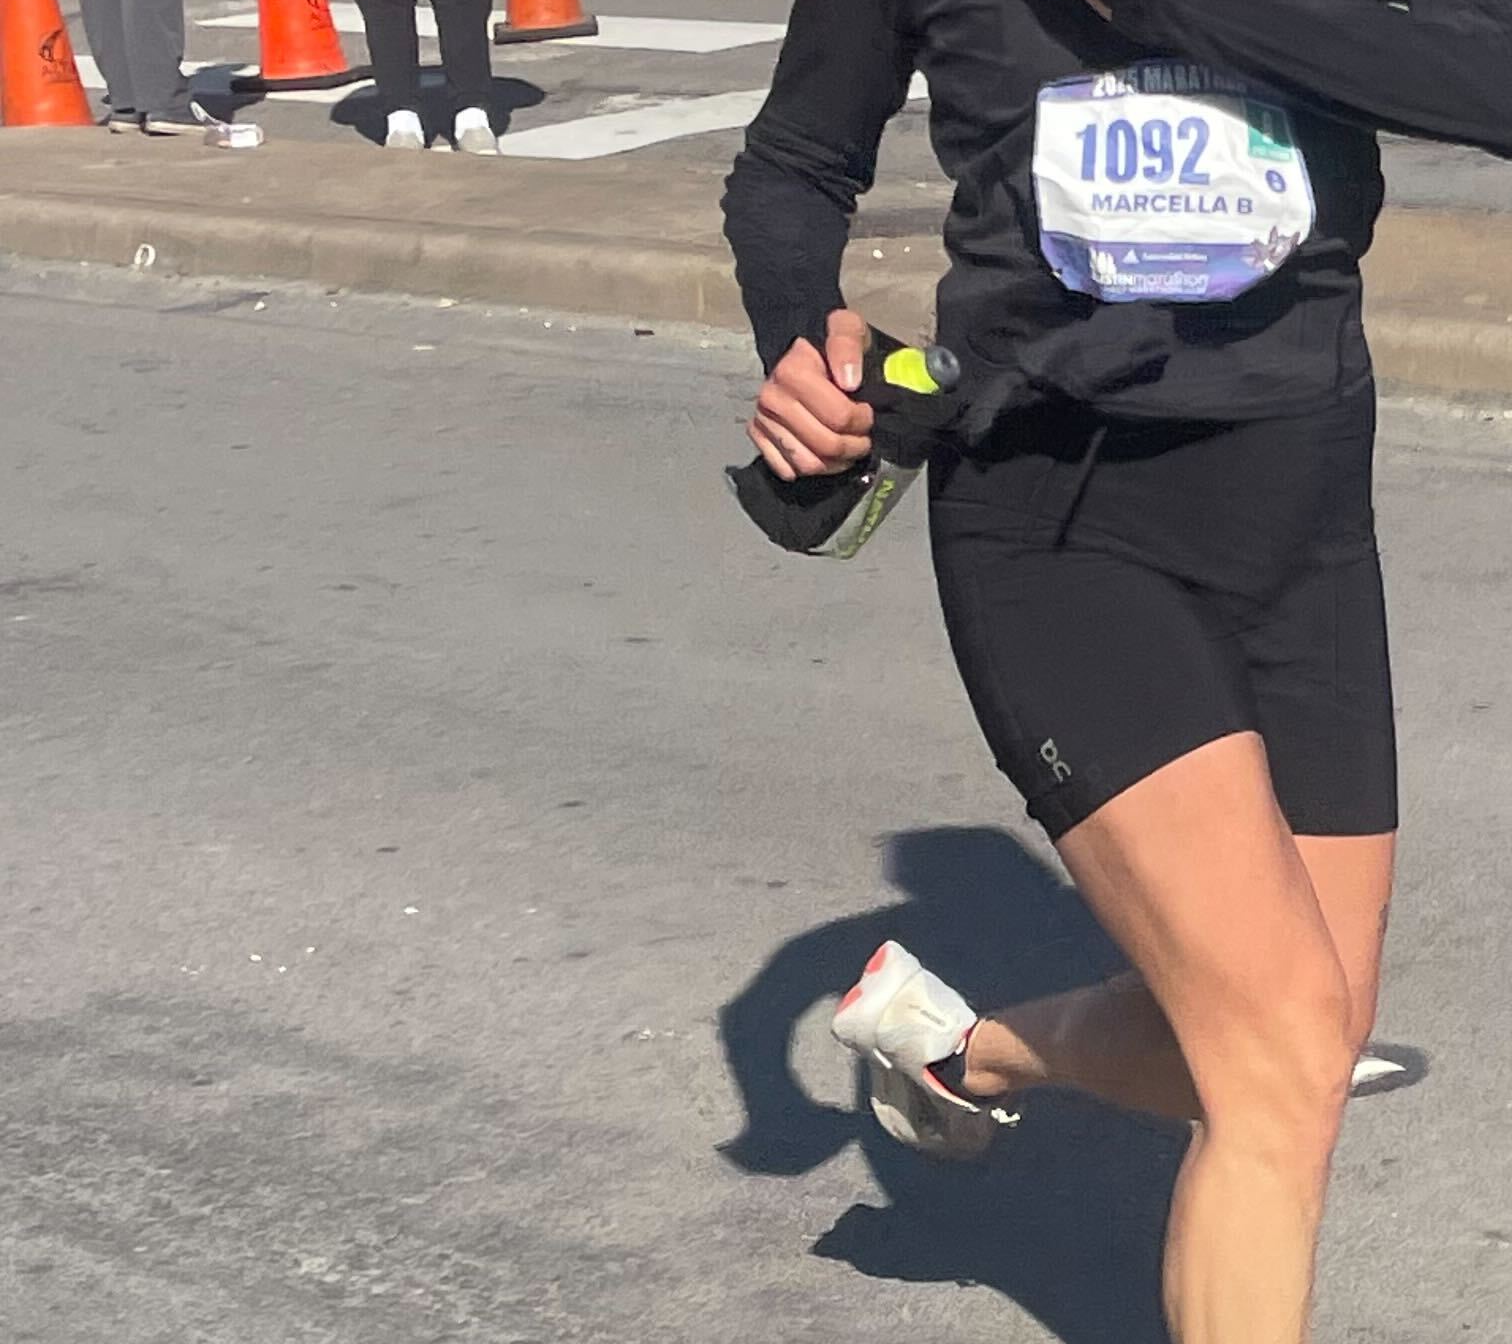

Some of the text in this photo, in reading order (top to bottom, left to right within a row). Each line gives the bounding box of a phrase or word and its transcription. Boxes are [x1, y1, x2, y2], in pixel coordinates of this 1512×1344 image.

[1075, 116, 1210, 186] 1092
[1091, 193, 1253, 215] MARCELLA B
